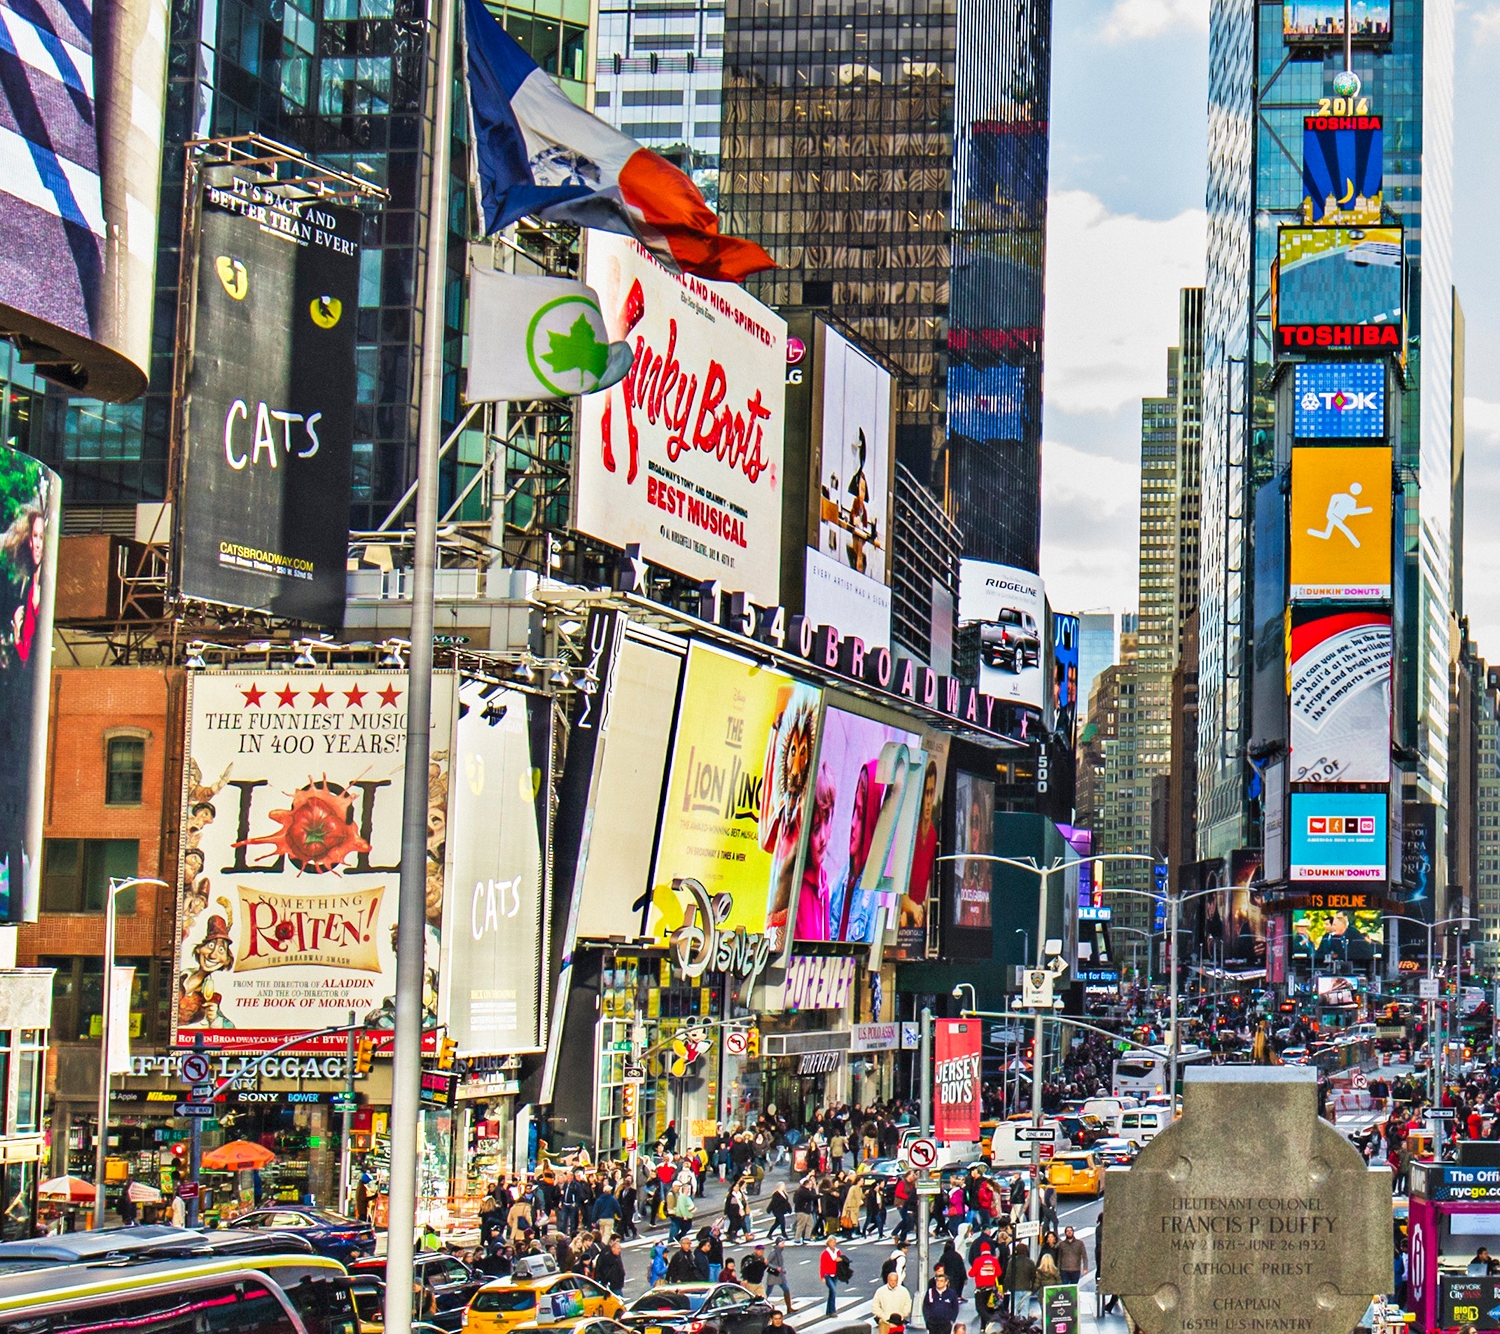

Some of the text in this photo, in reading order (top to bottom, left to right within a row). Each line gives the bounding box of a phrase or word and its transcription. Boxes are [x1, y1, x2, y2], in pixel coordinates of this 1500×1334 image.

[1305, 117, 1381, 130] TOSHIBA
[233, 176, 336, 230] IT'S BACK AND
[267, 209, 311, 243] THAN
[1279, 325, 1399, 347] TOSHIBA
[693, 359, 772, 484] Boots
[224, 399, 322, 469] CATS
[647, 475, 748, 549] BEST MUSICAL
[219, 541, 314, 572] CATSBROADWAY.COM
[985, 578, 1037, 598] RIDGELINE
[1344, 587, 1380, 596] DONUTS
[825, 628, 995, 723] BROADWAY
[1306, 663, 1321, 677] can
[206, 713, 344, 731] THE FUNNIEST
[238, 735, 314, 755] IN 400
[258, 893, 363, 910] SOMETHING
[1328, 895, 1366, 907] DECLINE
[322, 978, 375, 989] ALADDIN
[318, 998, 371, 1008] MORMON
[935, 1053, 980, 1084] JERSEY
[146, 1092, 319, 1102] Nikon SONY BOWER
[941, 1077, 973, 1104] BOYS
[1450, 1171, 1475, 1182] The
[1172, 1198, 1324, 1211] LIEUTENANT COLONEL
[1161, 1217, 1337, 1233] FRANCIS DUFFY
[1182, 1263, 1313, 1275] CATHOLIC PRIEST
[1213, 1298, 1281, 1310] CHAPLAIN
[1252, 1319, 1313, 1330] INFANTRY
